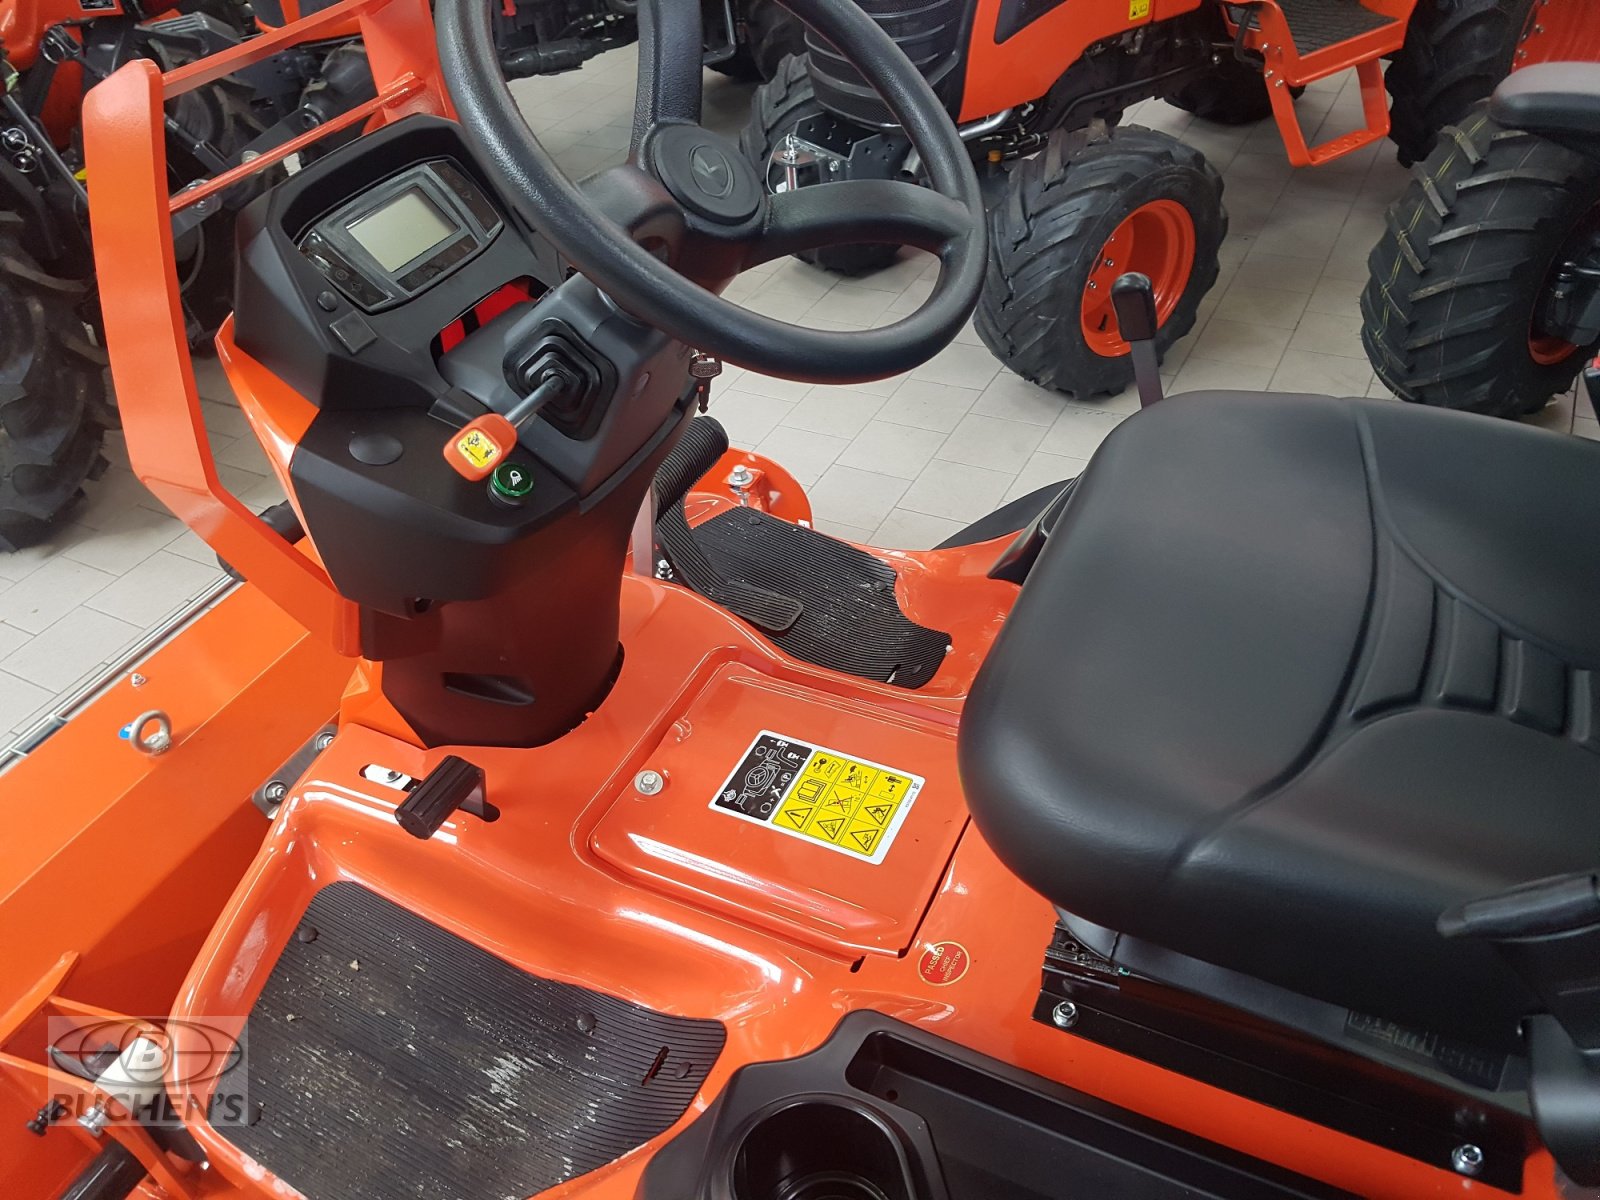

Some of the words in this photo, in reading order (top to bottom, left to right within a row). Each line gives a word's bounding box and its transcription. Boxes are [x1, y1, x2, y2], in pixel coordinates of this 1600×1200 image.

[925, 946, 944, 974] PASSED
[940, 955, 950, 972] CHIEF
[943, 951, 962, 981] INSPECTOR
